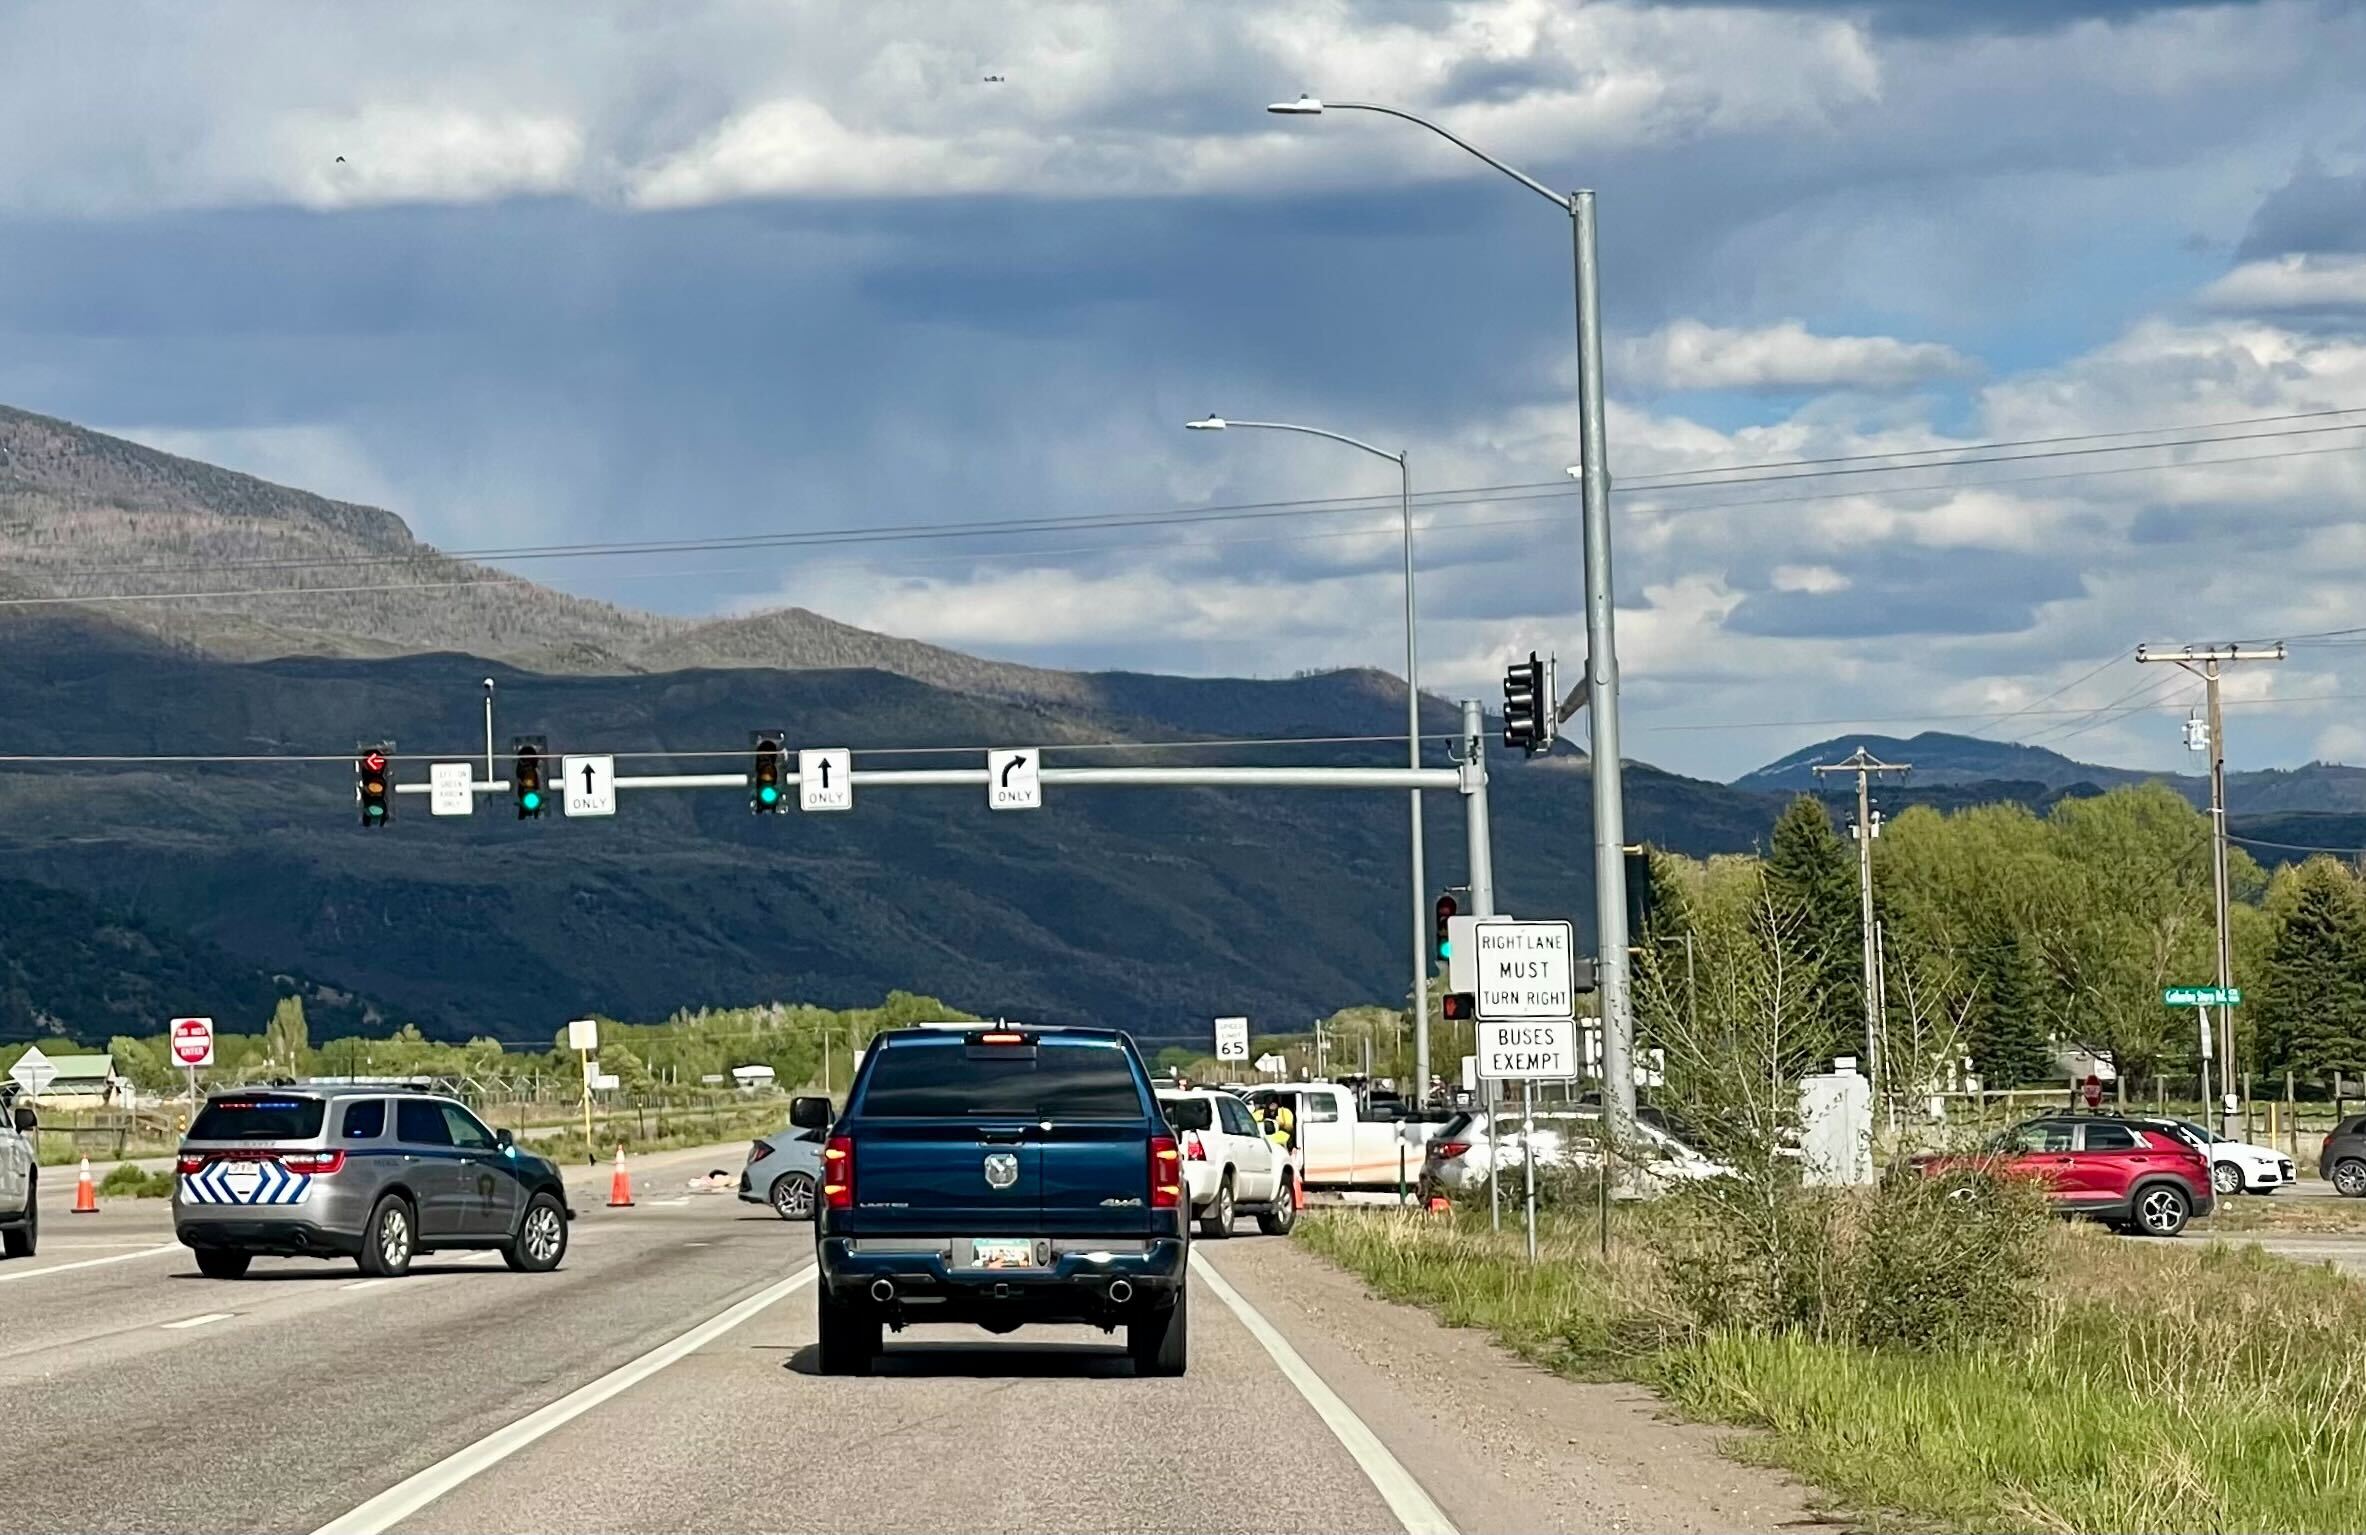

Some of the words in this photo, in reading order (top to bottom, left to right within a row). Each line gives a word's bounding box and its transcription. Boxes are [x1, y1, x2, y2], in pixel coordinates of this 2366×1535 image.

[573, 797, 607, 809] ONLY
[809, 792, 844, 804] ONLY
[998, 791, 1032, 802] ONLY
[1482, 935, 1522, 949] RIGHT
[1527, 935, 1563, 949] LANE
[1499, 961, 1549, 978] MUST
[1483, 990, 1519, 1005] TURN
[1527, 991, 1567, 1005] RIGHT
[177, 1027, 188, 1036] DO
[190, 1027, 206, 1036] NOT
[1498, 1028, 1554, 1045] BUSES
[180, 1046, 204, 1056] ENTER
[1221, 1041, 1244, 1055] 65
[1493, 1053, 1560, 1071] EXEMPT
